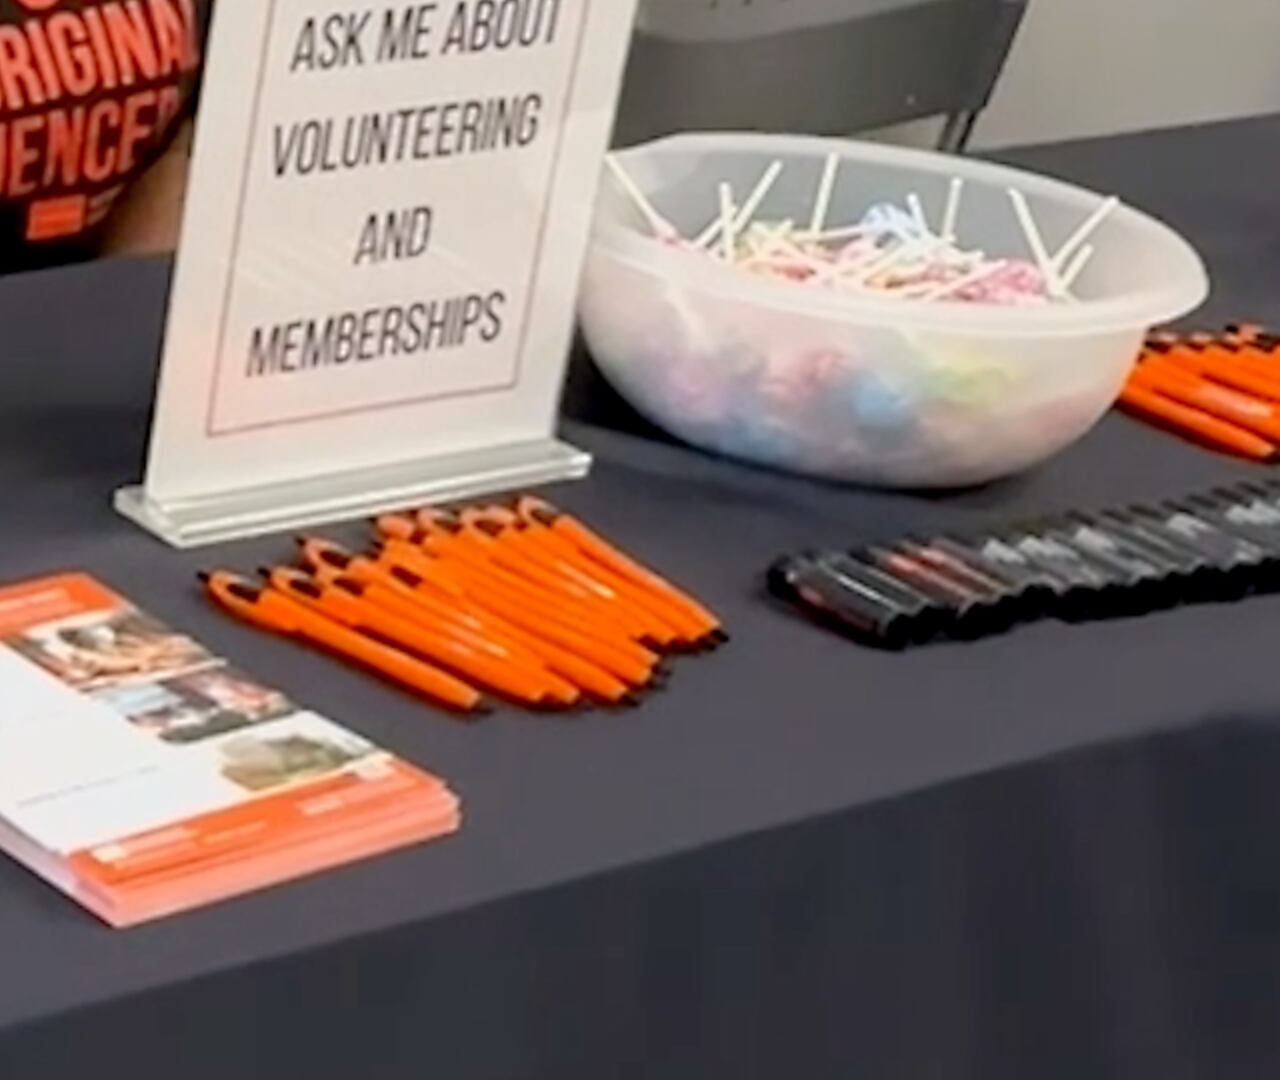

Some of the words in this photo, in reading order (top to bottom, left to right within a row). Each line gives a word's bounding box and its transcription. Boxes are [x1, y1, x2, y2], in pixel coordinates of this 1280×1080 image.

[290, 9, 366, 73] ASK
[375, 2, 431, 63] ME
[273, 94, 543, 178] VOLUNTEERING
[352, 204, 432, 266] AND
[244, 290, 507, 378] MEMBERSHIPS
